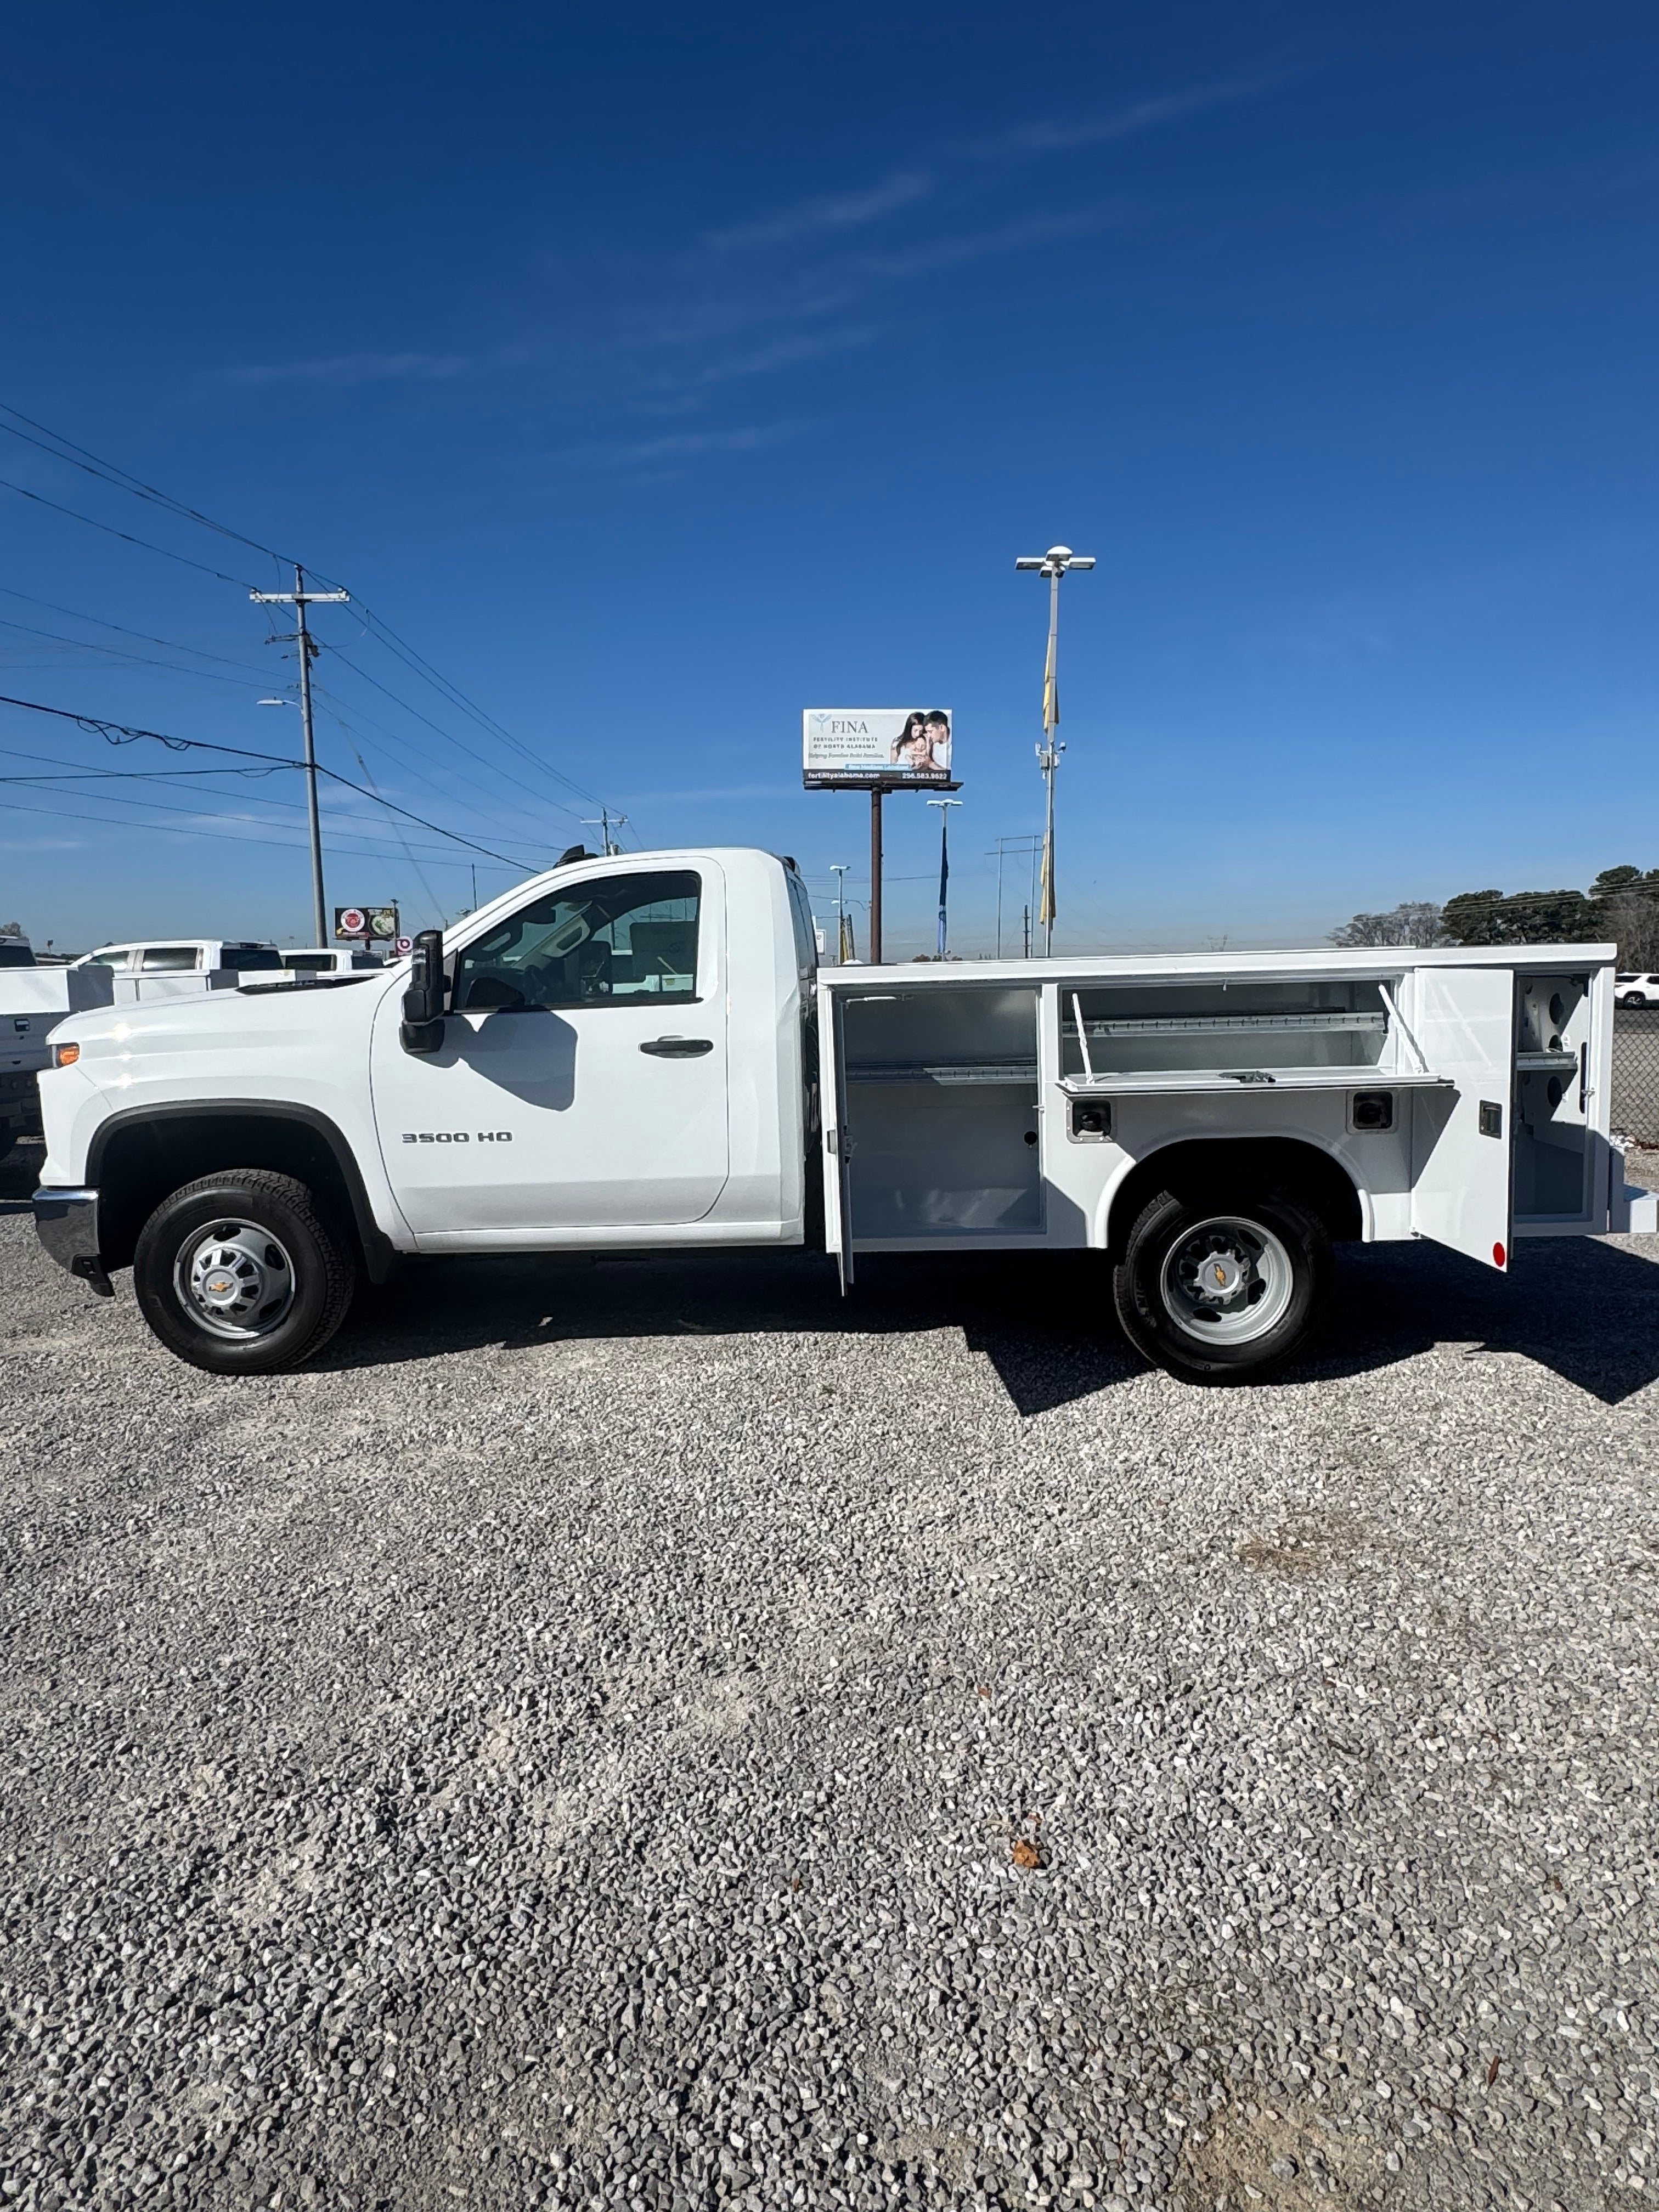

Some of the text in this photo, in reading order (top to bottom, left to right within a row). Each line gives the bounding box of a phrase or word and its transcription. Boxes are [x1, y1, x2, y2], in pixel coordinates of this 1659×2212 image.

[831, 721, 869, 733] FINA
[402, 1132, 512, 1143] 3500 HD
